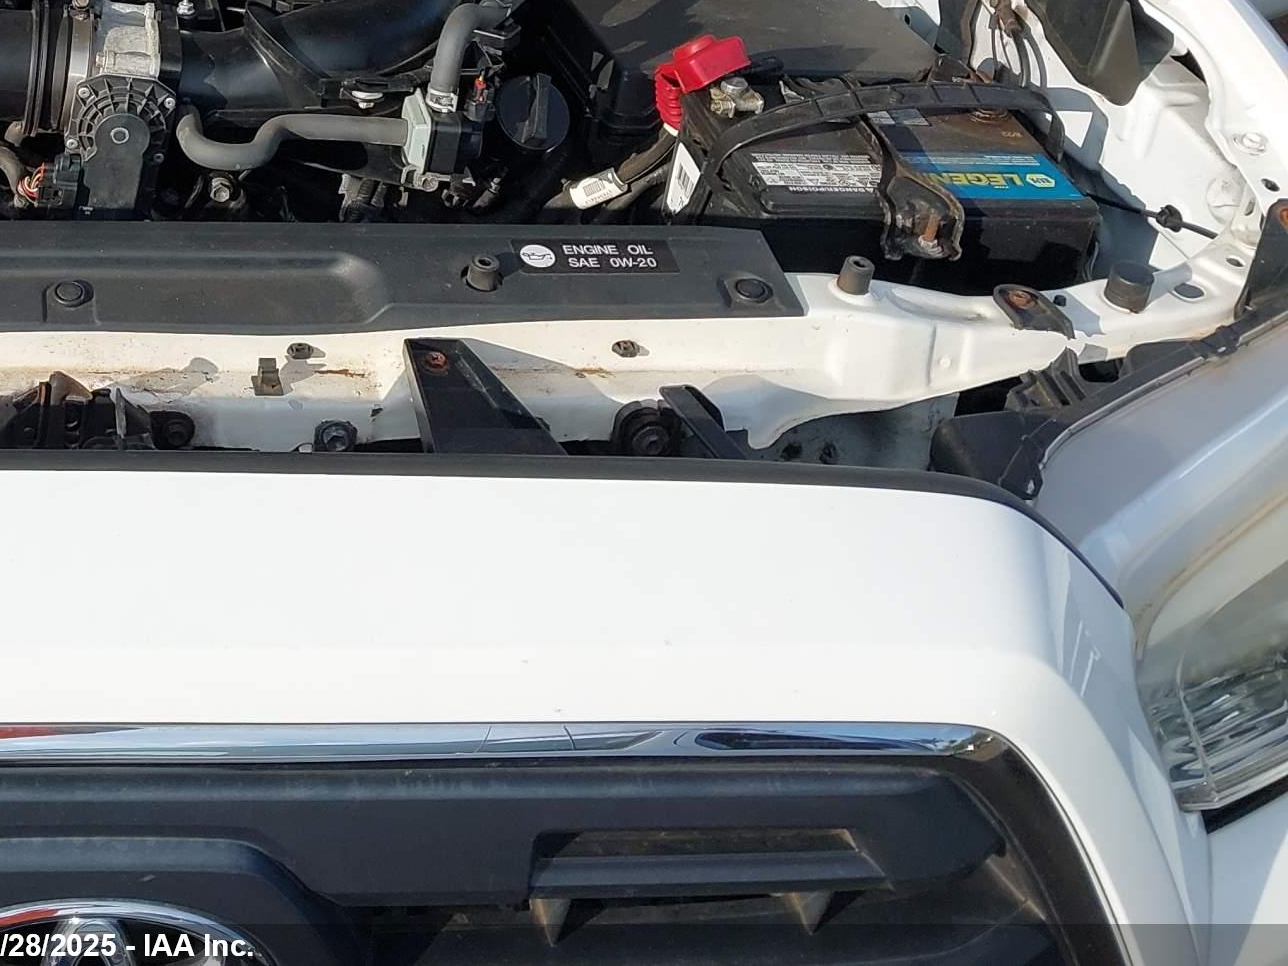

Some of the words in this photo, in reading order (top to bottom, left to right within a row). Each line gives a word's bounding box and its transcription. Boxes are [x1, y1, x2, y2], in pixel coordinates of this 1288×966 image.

[562, 244, 619, 255] ENGINE
[627, 244, 654, 255] OIL
[568, 257, 601, 268] SAE
[609, 257, 657, 268] 0W-20
